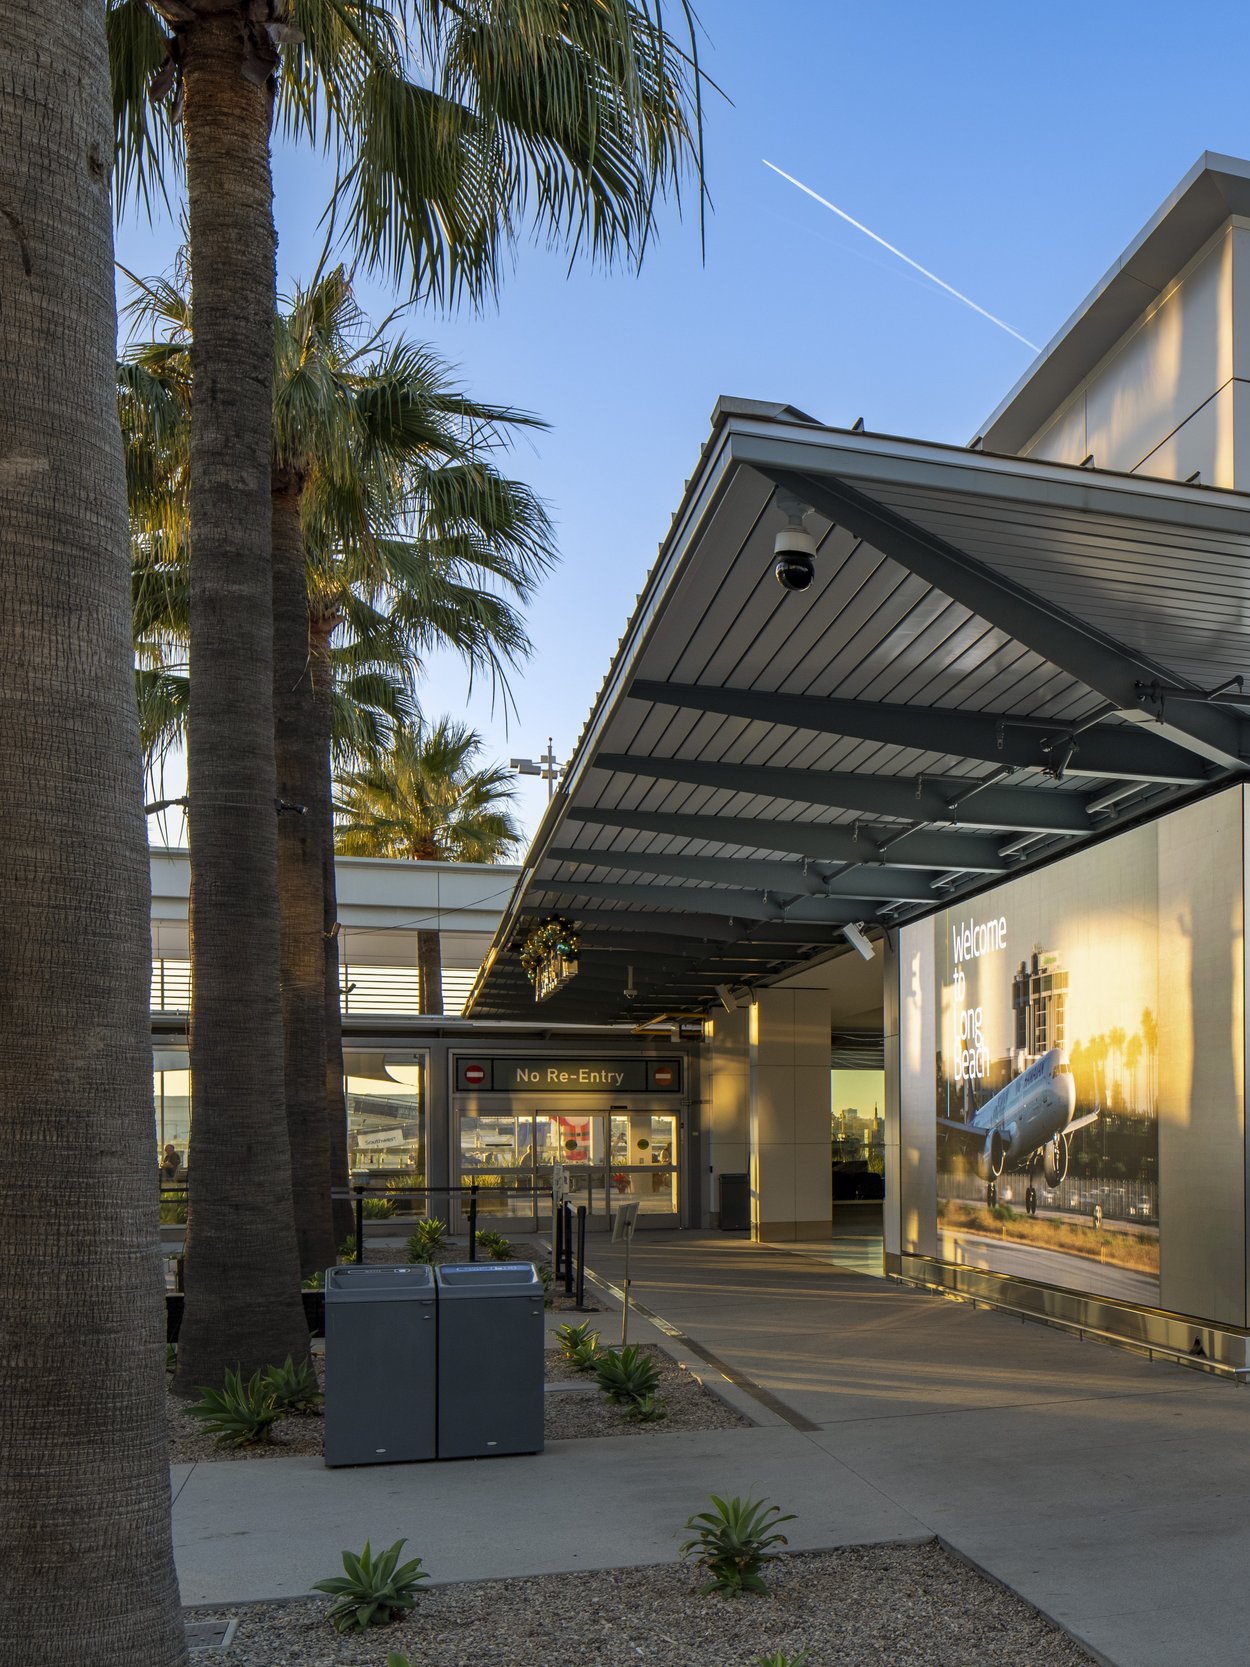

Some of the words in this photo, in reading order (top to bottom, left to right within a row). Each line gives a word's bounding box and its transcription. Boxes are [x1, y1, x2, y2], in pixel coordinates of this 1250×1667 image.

[952, 916, 1007, 963] Welcome
[952, 967, 966, 1001] to
[953, 1001, 983, 1048] Long
[516, 1068, 540, 1083] No
[547, 1068, 624, 1086] Re-Entry
[953, 1037, 990, 1081] Beach
